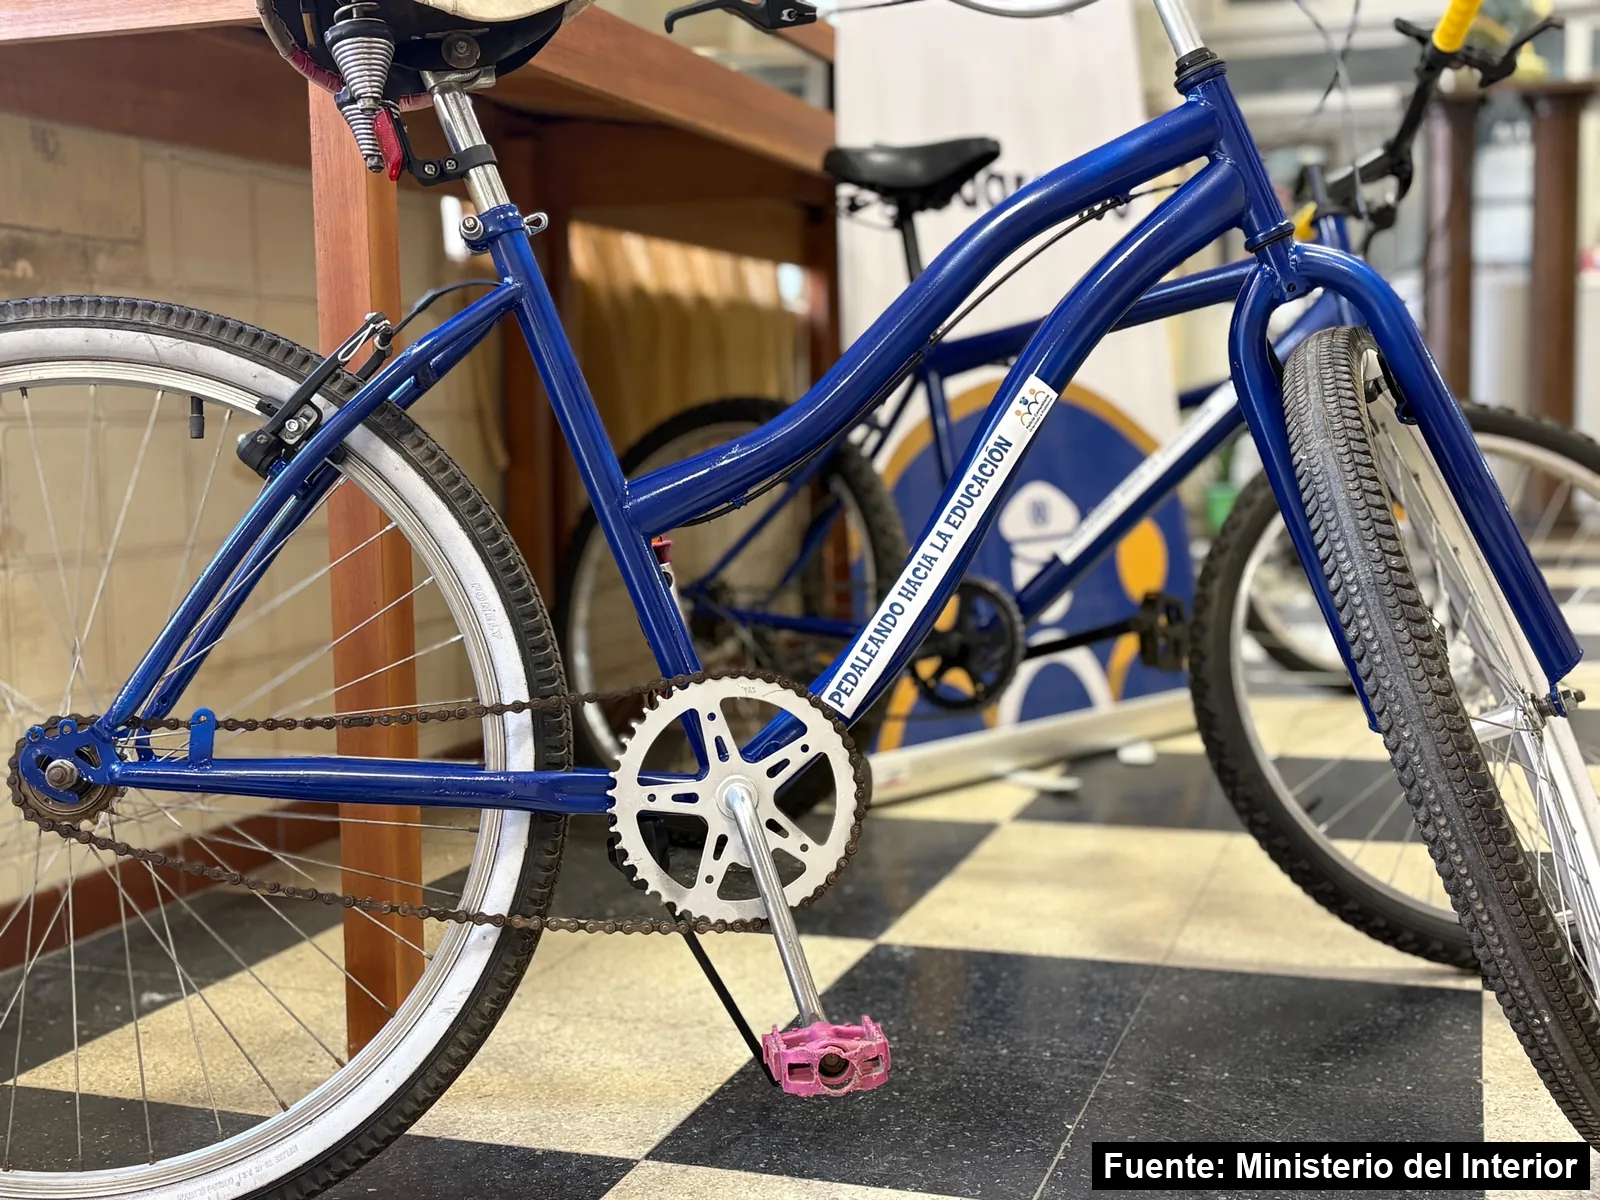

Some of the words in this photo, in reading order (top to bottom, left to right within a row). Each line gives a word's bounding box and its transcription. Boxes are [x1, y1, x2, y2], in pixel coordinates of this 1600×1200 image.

[828, 602, 905, 708] PEDALEANDO
[898, 553, 938, 602] HACIA
[929, 530, 953, 553] LA
[944, 435, 1013, 530] EDUCACIÓN
